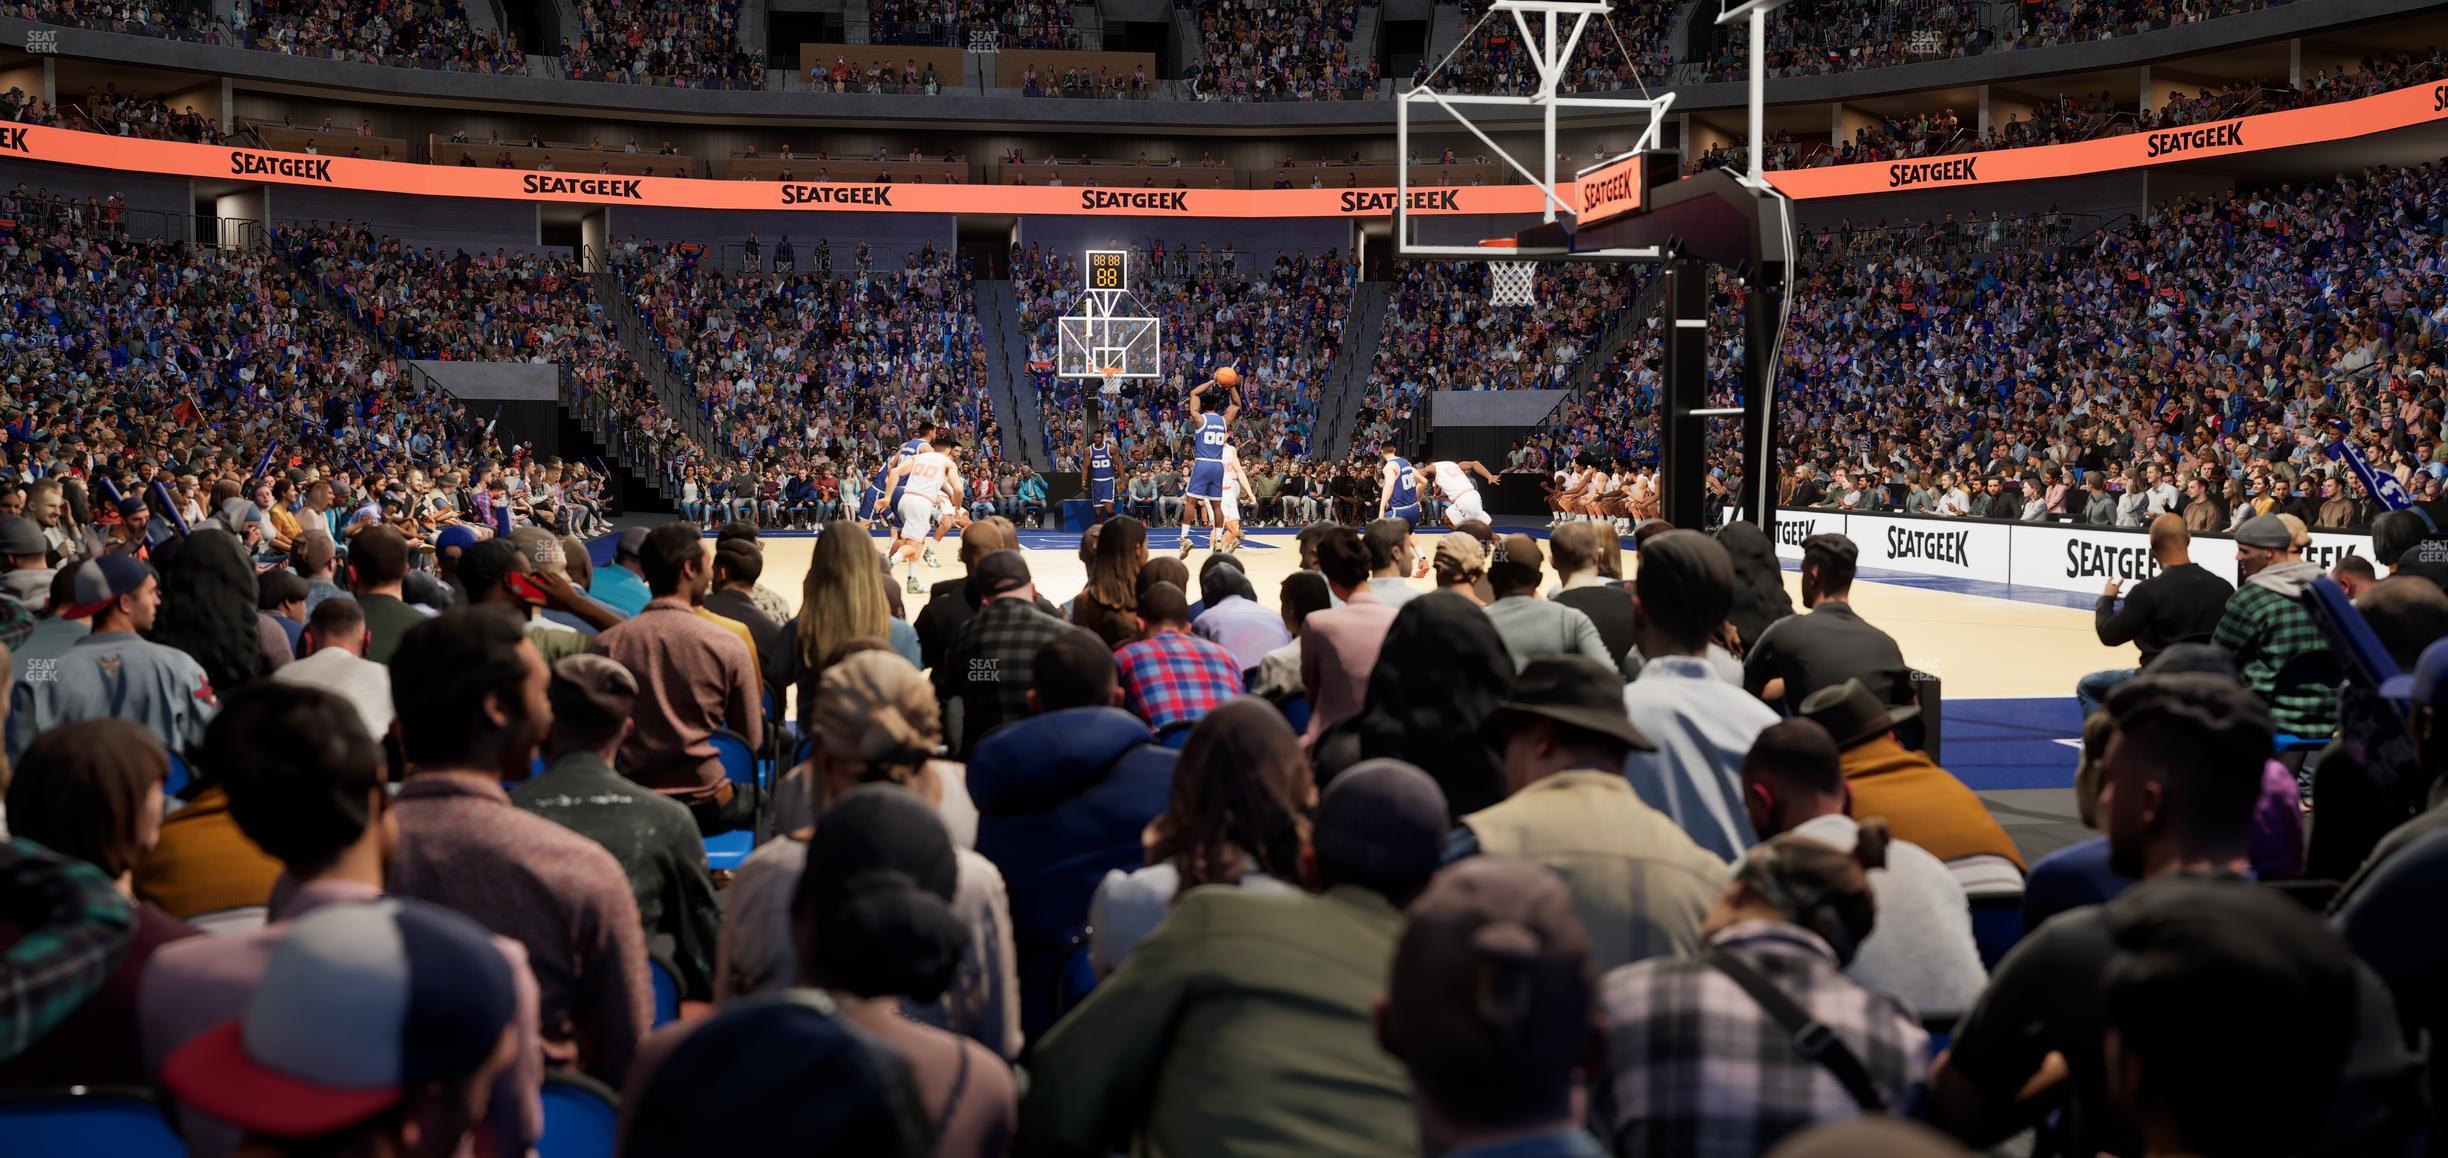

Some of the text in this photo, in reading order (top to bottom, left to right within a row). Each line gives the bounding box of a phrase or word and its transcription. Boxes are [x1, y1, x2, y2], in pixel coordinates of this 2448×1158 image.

[2147, 120, 2244, 158] SEATGEEK
[231, 151, 332, 182] SEATGEEK
[1890, 156, 1978, 187] SEATGEEK
[523, 174, 642, 200] SEATGEEK
[781, 184, 892, 206] SEATGEEK
[1081, 189, 1188, 211] SEATGEEK
[1584, 167, 1632, 213] SEATGEEK
[1096, 268, 1117, 287] 88
[1203, 431, 1225, 446] 00
[1886, 525, 1969, 568] SEATGEEK
